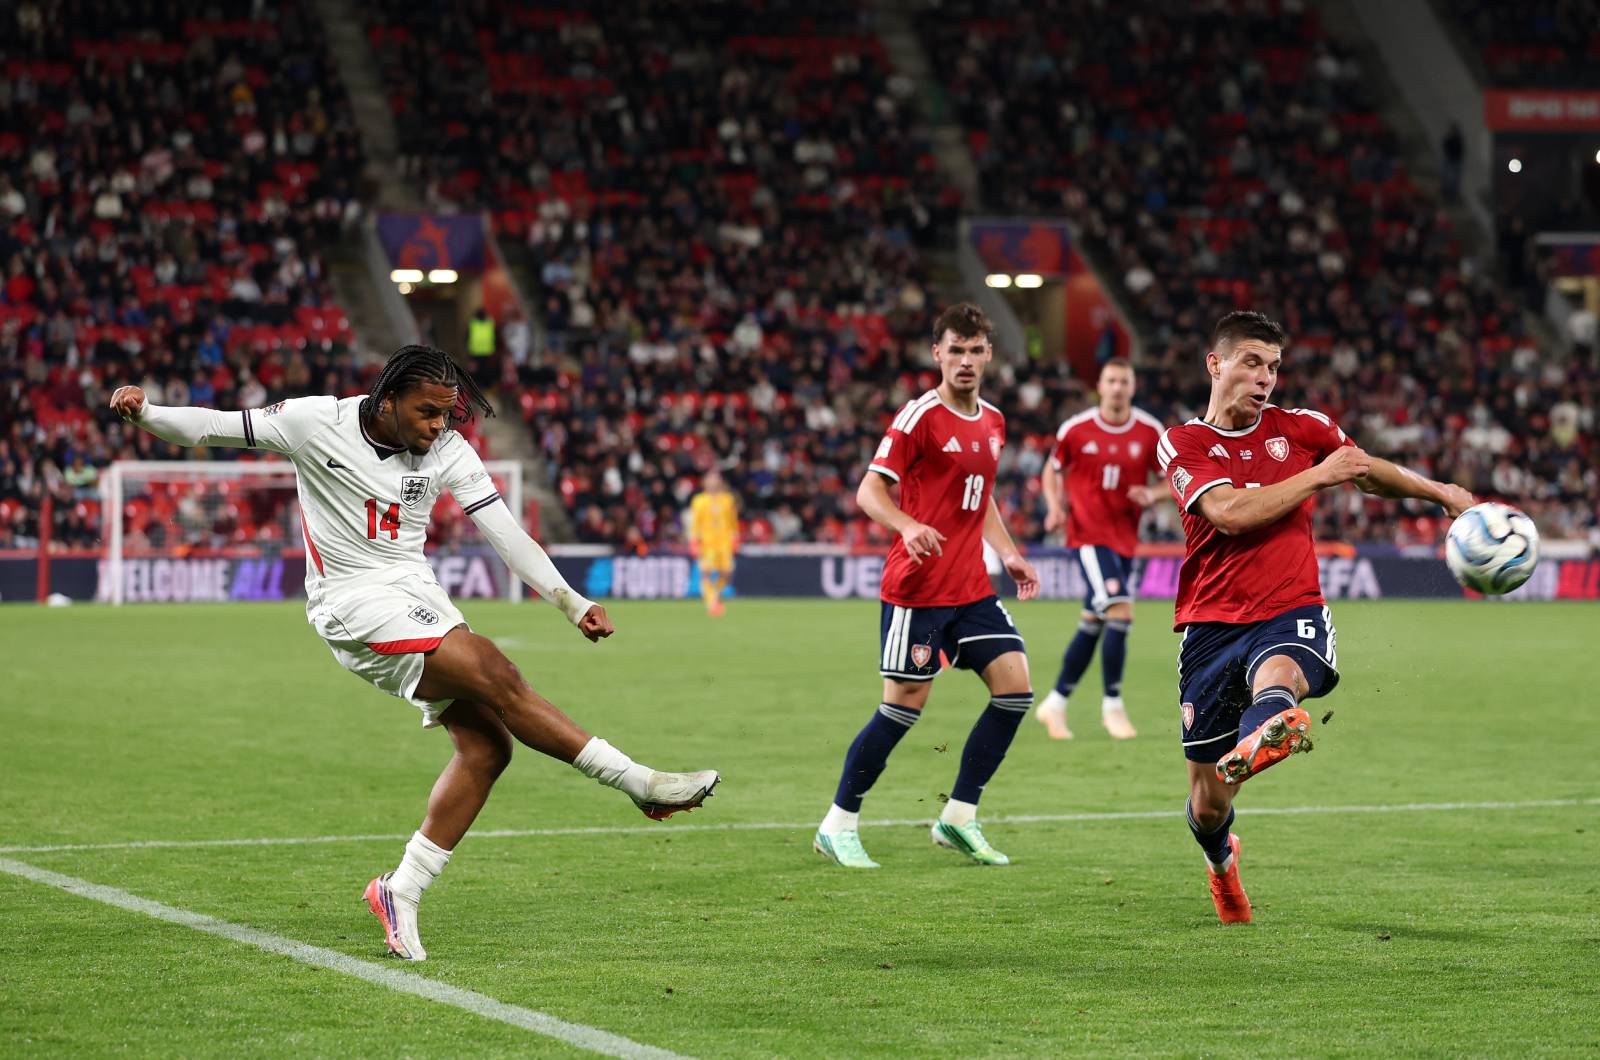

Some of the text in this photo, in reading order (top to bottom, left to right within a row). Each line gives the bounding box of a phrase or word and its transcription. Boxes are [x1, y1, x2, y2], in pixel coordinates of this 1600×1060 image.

[961, 473, 985, 512] 13
[1103, 464, 1120, 490] 11
[364, 498, 401, 541] 14
[426, 556, 497, 599] FA
[821, 556, 884, 600] UE
[1318, 557, 1383, 600] FA
[1296, 618, 1316, 640] 6
